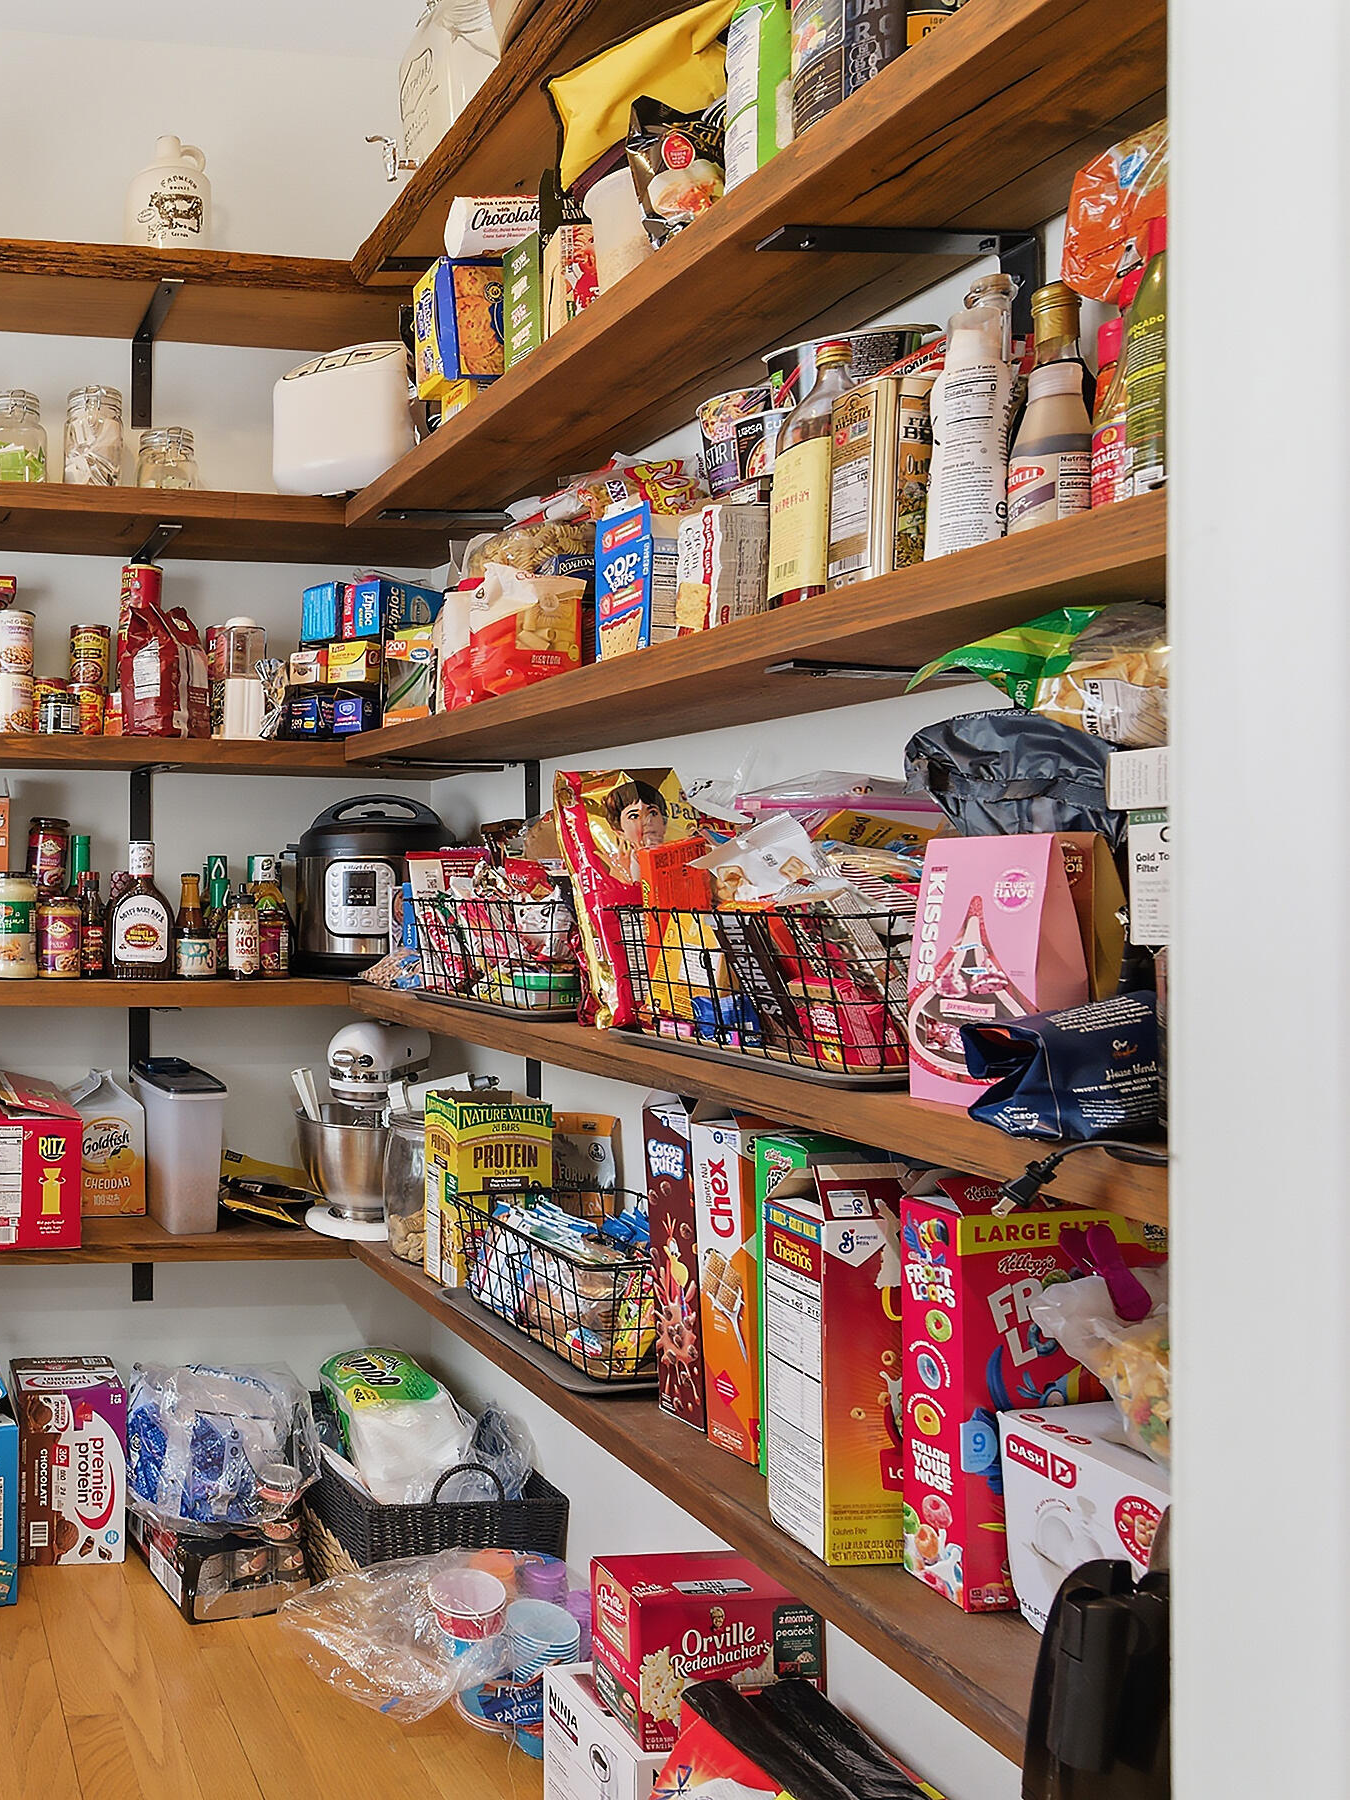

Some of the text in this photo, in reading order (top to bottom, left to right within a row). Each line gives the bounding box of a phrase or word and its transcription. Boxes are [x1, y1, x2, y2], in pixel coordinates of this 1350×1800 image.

[388, 641, 406, 650] 200
[1135, 852, 1156, 862] Gold
[1136, 863, 1160, 874] Filter
[993, 887, 1035, 899] FLAVOR
[235, 935, 257, 949] HOT
[462, 1107, 550, 1128] NATURE VALLEY
[501, 1123, 520, 1132] BARS
[38, 1136, 67, 1156] RITZ
[82, 1129, 130, 1156] Goldfish
[648, 1139, 684, 1160] Cocoa
[473, 1144, 538, 1169] PROTEIN
[84, 1175, 131, 1190] CHEDDAR
[707, 1158, 736, 1239] Chex
[974, 1222, 1052, 1243] LARGE
[773, 1238, 813, 1272] Cheerios
[998, 1252, 1057, 1276] Kellogg's
[904, 1263, 953, 1284] FROOT
[910, 1282, 956, 1308] LOOPS
[911, 1437, 951, 1464] FOLLOW
[972, 1432, 987, 1454] 9
[1008, 1439, 1046, 1469] DASH
[74, 1442, 93, 1506] protein
[89, 1437, 108, 1510] premier
[913, 1450, 953, 1480] YOUR
[39, 1448, 48, 1507] CHOCOLATE
[914, 1464, 954, 1497] NOSE
[832, 1527, 868, 1536] Gluten Free
[681, 1621, 757, 1657] Orville
[775, 1625, 815, 1640] peacock
[670, 1639, 773, 1679] Redenbacher's
[494, 1703, 539, 1723] PARTY
[549, 1684, 579, 1731] NINJA
